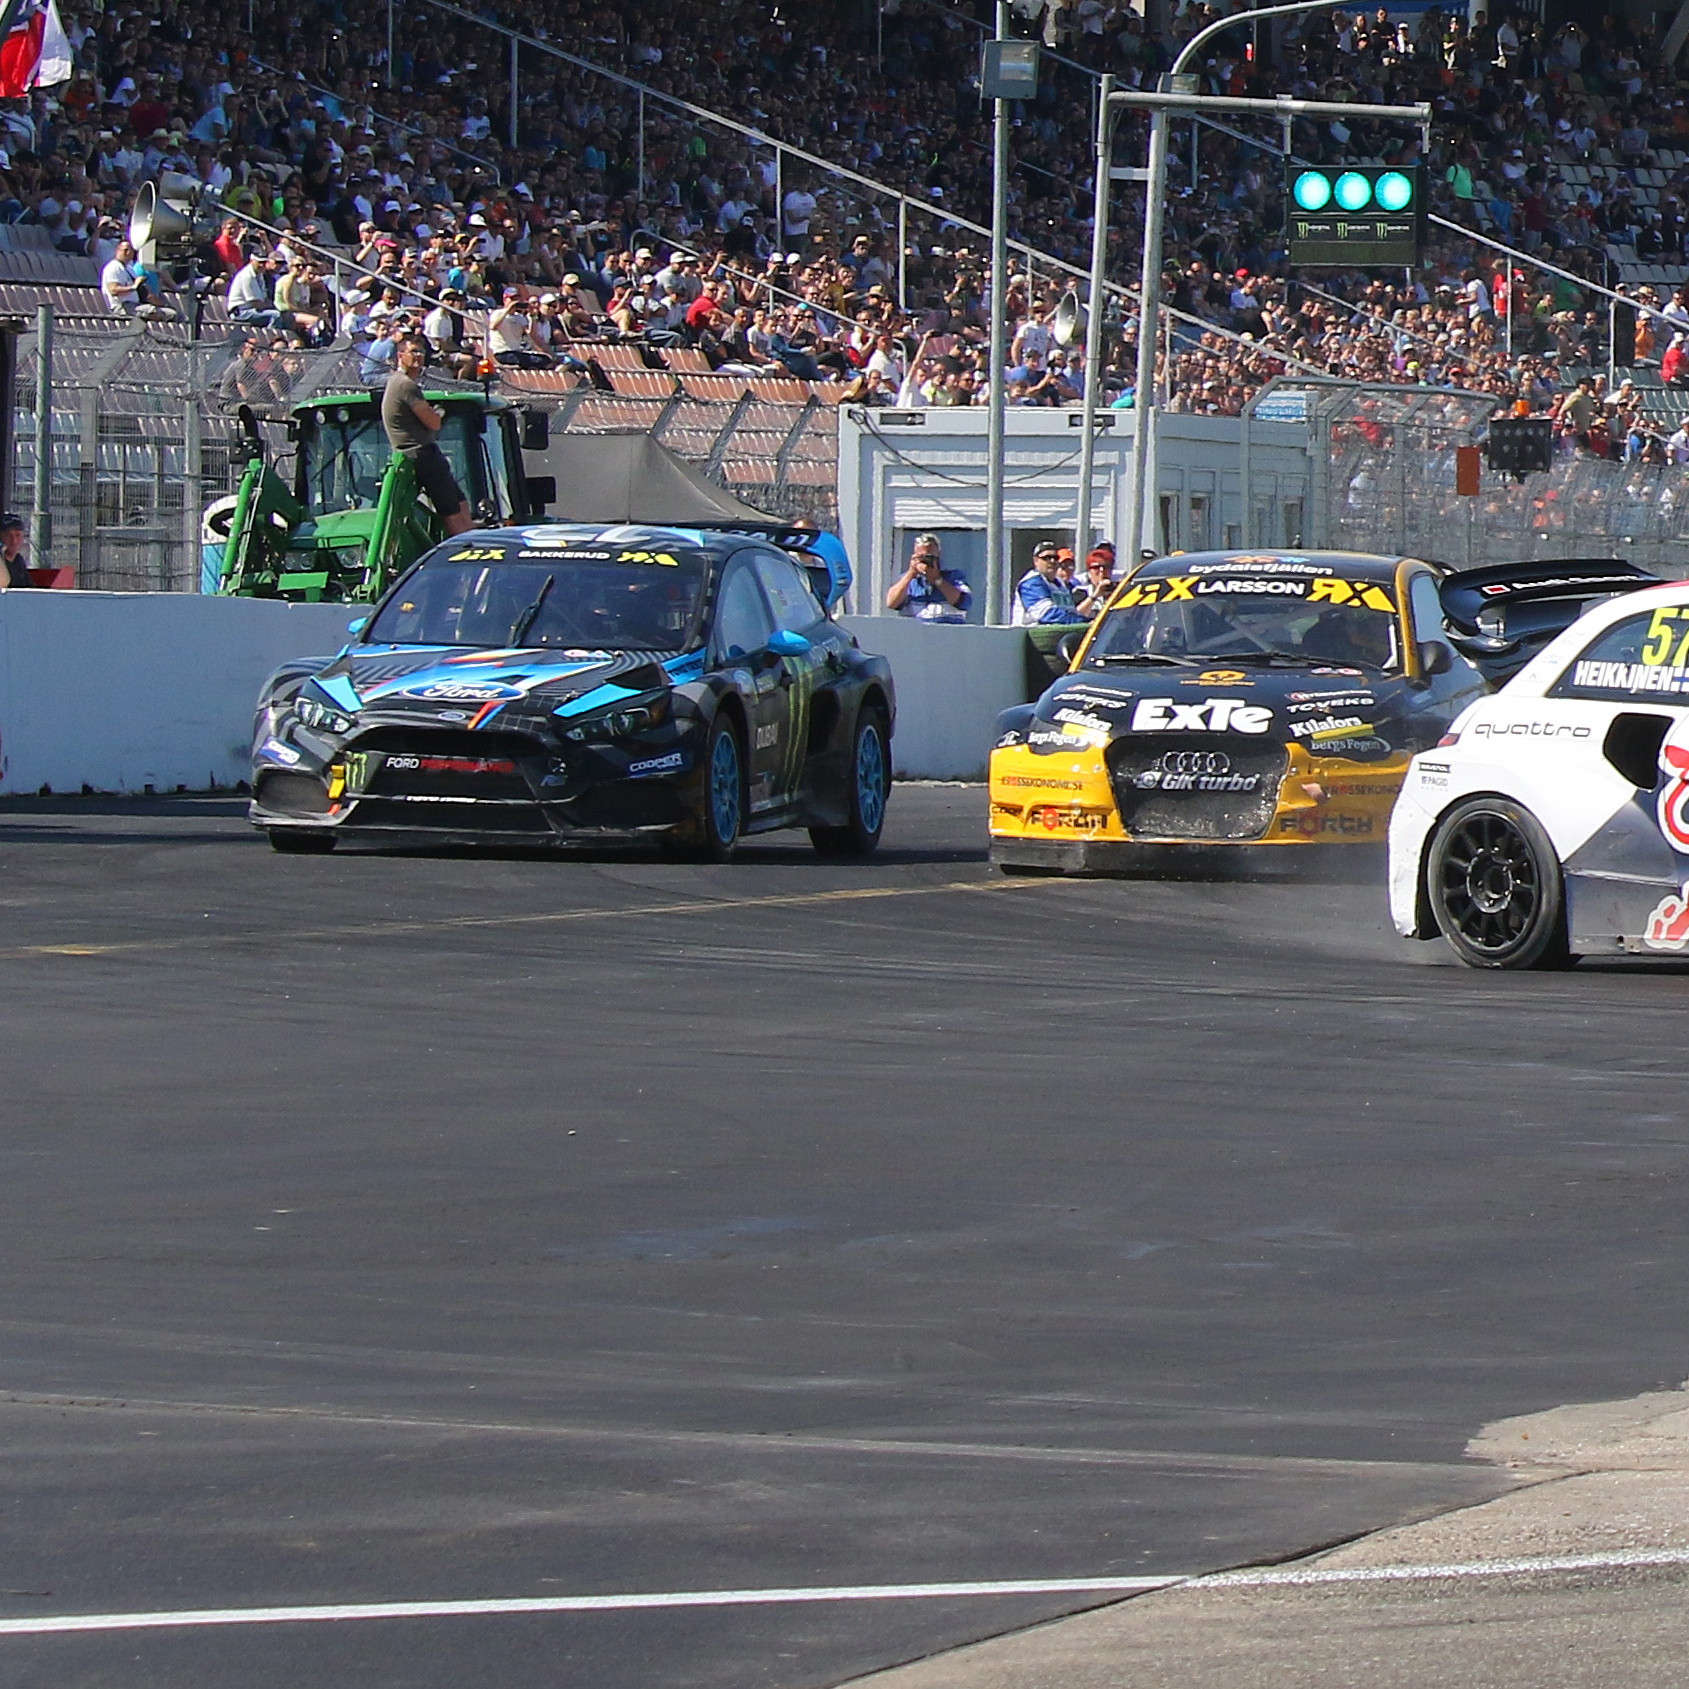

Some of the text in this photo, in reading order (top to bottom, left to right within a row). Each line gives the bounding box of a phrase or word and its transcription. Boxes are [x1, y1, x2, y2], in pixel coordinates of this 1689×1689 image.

[518, 550, 611, 560] BAKKERUD
[1197, 580, 1306, 595] LARSSON
[1573, 661, 1675, 692] HEIKKINEN
[425, 682, 503, 699] Ford
[1052, 708, 1113, 732] Kilafors
[1131, 697, 1275, 734] ExTe
[1288, 715, 1363, 738] Kilafors
[1475, 722, 1592, 739] quattro
[386, 757, 420, 769] FORD
[629, 752, 683, 773] COOPER
[1199, 773, 1256, 791] turbo
